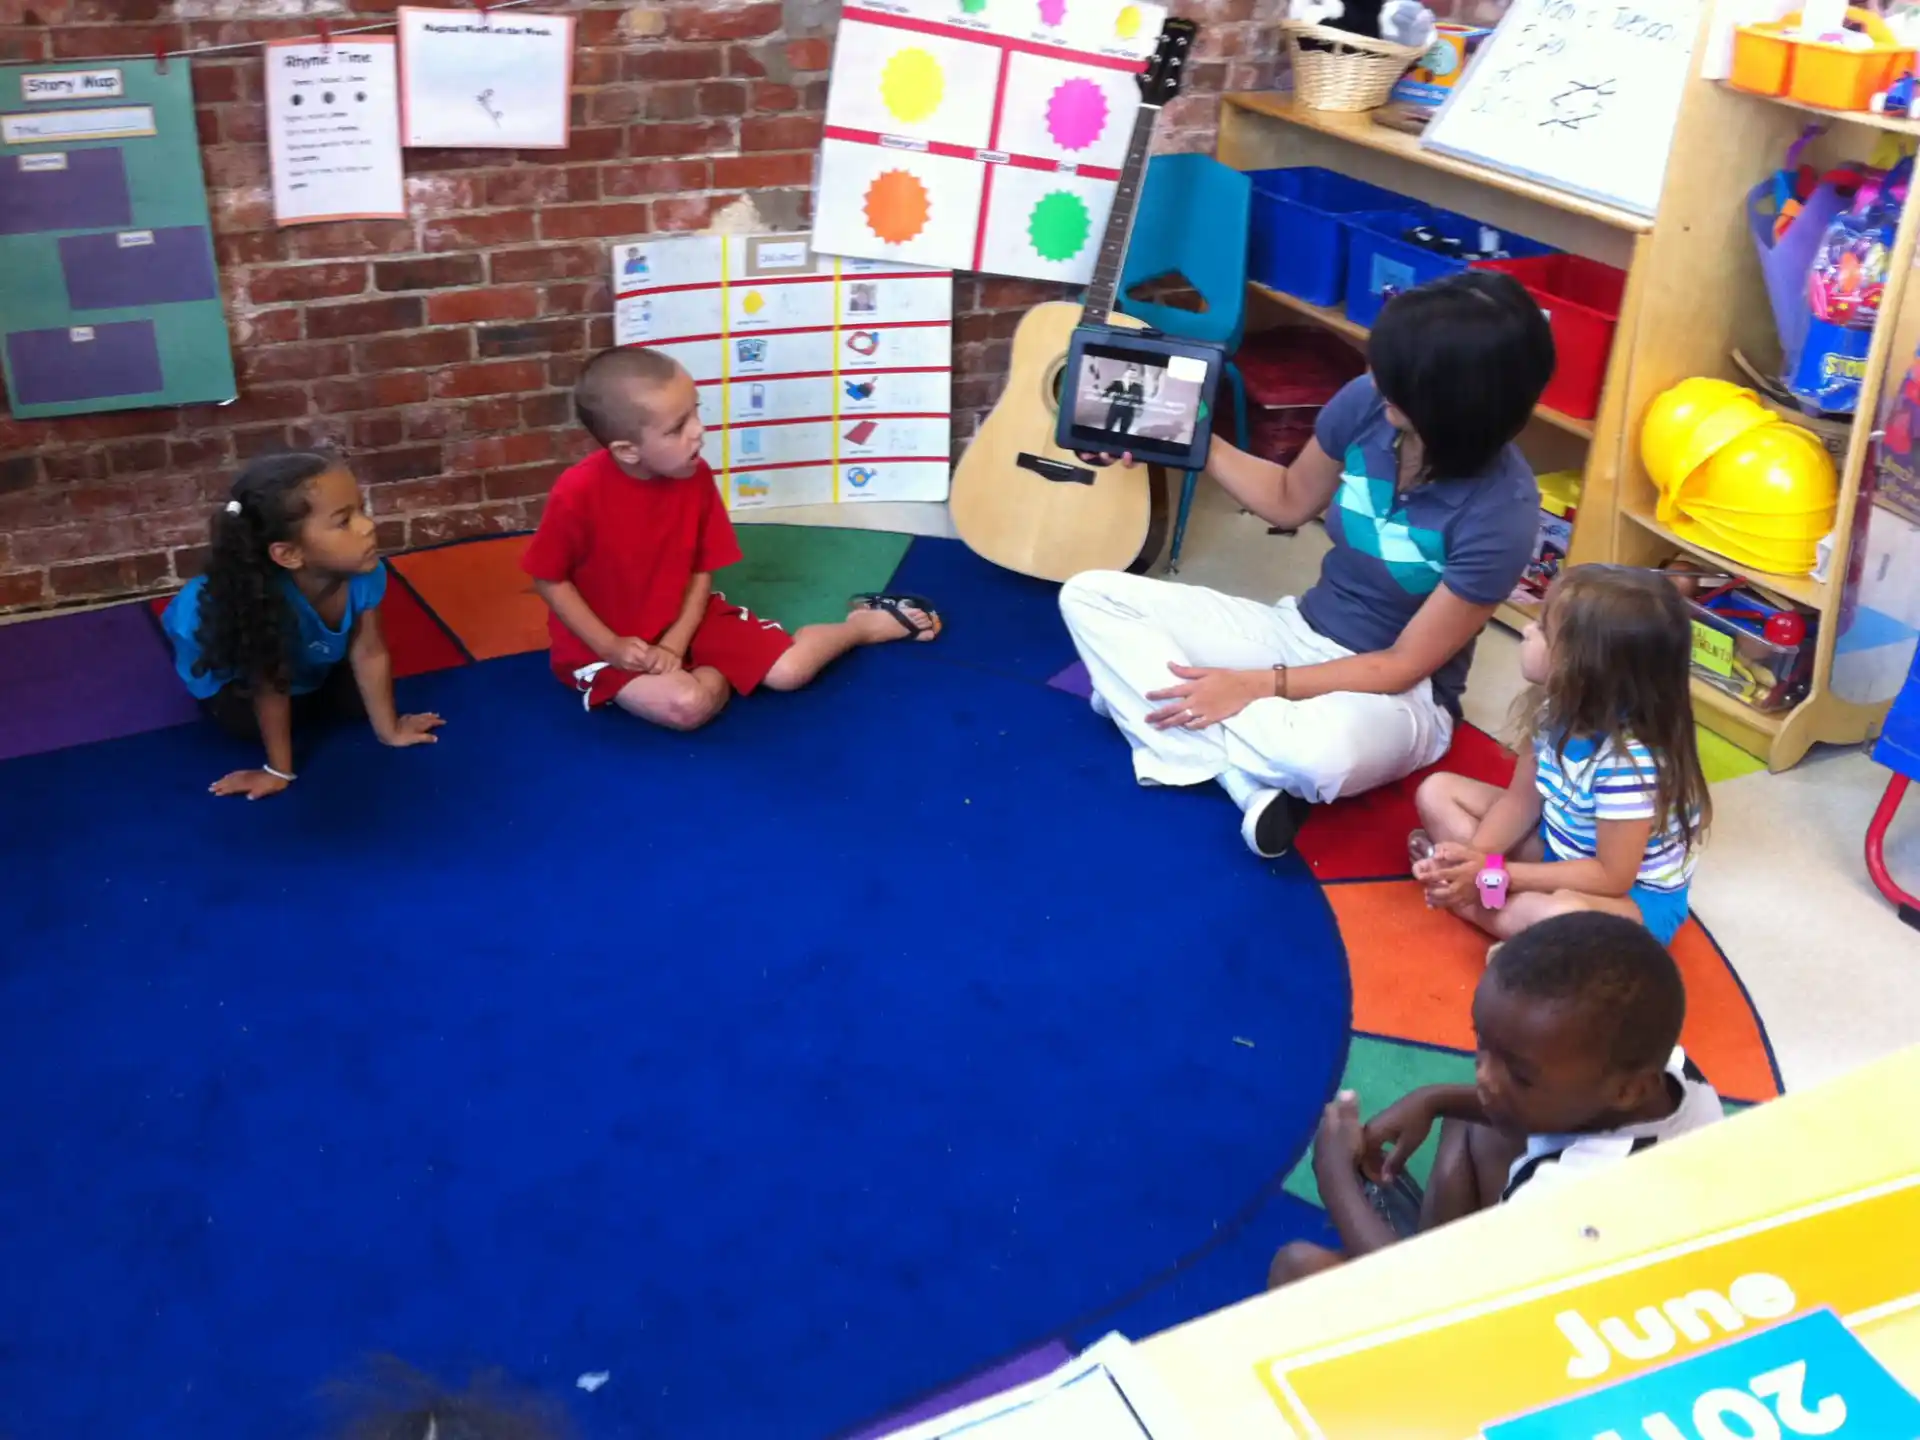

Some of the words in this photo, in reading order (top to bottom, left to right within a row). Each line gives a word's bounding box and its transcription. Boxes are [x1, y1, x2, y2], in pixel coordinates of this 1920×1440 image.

[284, 54, 331, 69] Rhyme
[336, 51, 372, 63] Time
[28, 78, 75, 94] Story
[1554, 1272, 1796, 1379] June
[1593, 1359, 1847, 1440] 20
